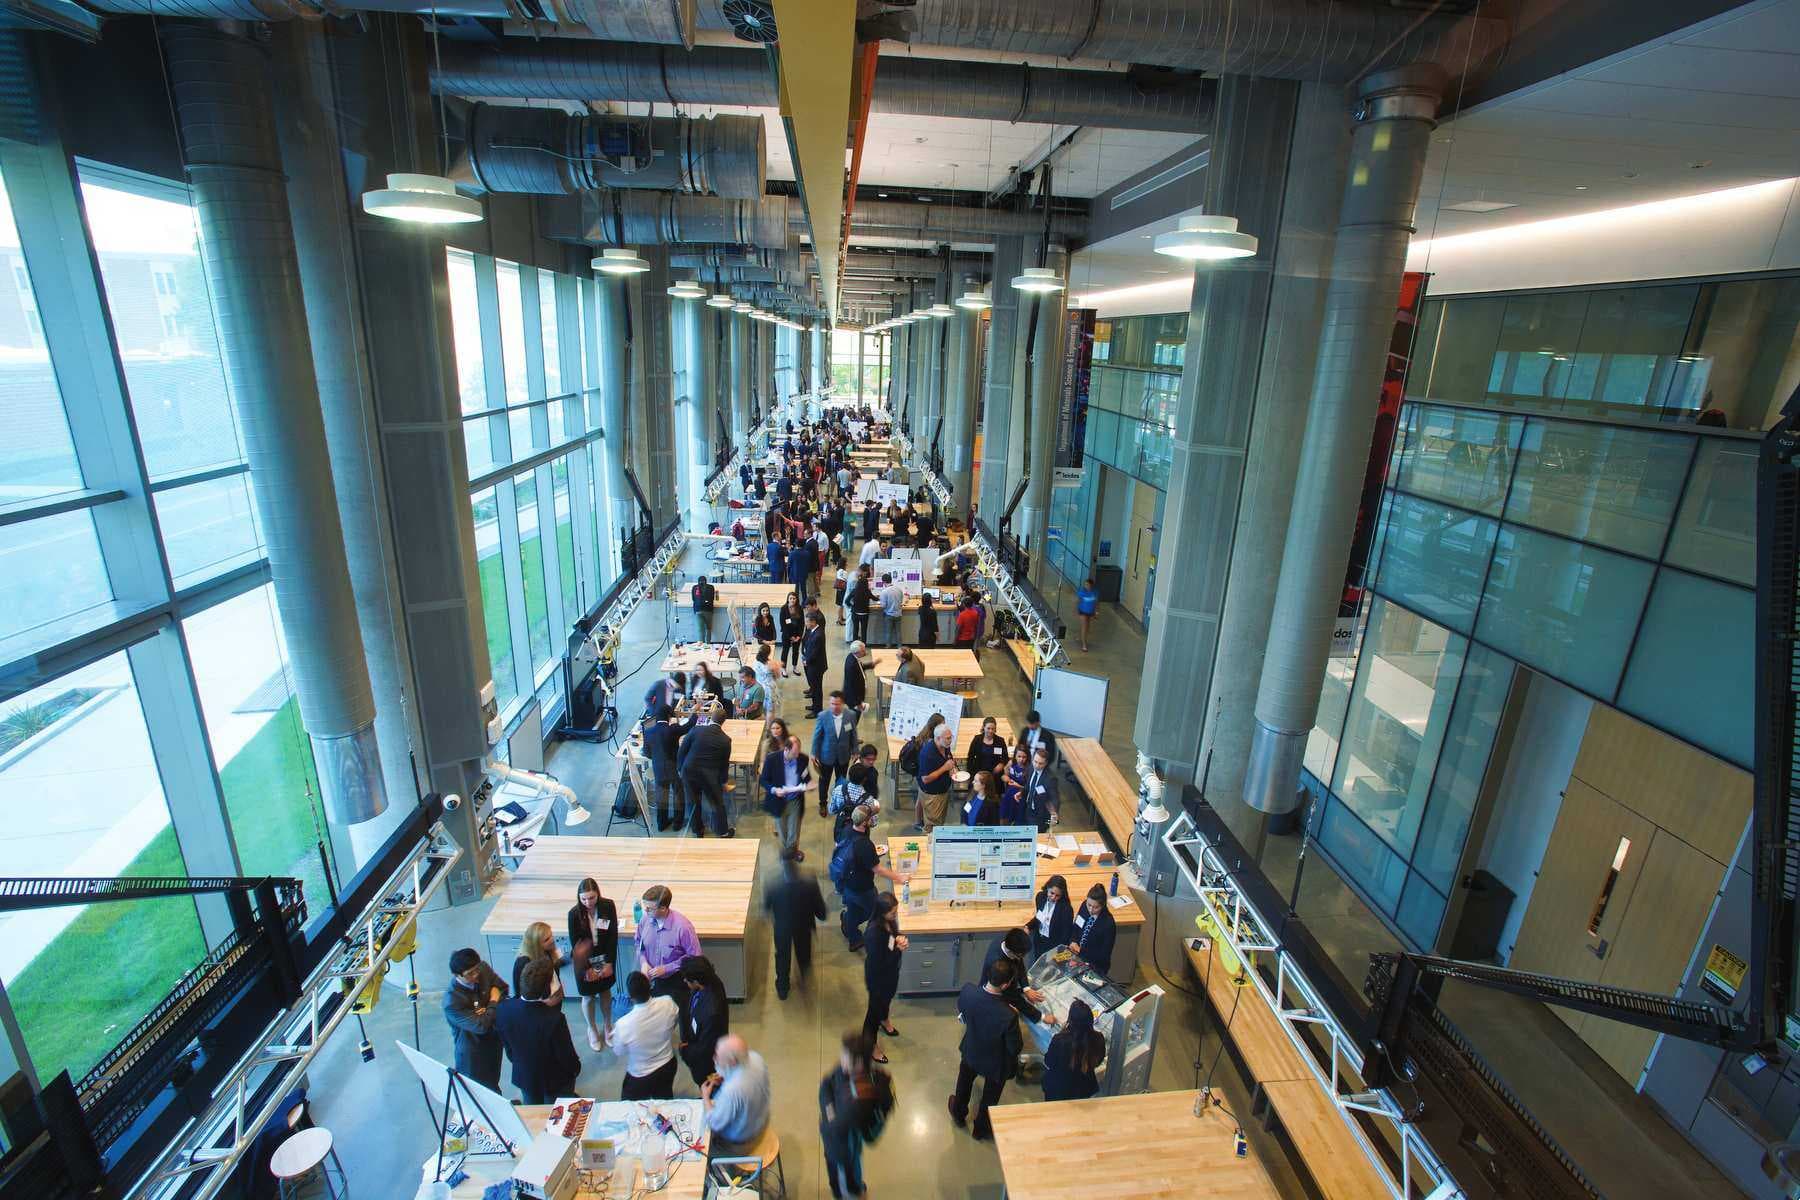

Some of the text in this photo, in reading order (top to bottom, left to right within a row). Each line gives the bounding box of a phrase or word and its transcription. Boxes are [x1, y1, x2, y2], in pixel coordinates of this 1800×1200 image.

[1066, 324, 1078, 358] Engineering
[1064, 365, 1073, 386] Science
[1062, 387, 1072, 413] Materials
[1058, 421, 1070, 452] Department
[1334, 628, 1353, 638] dos
